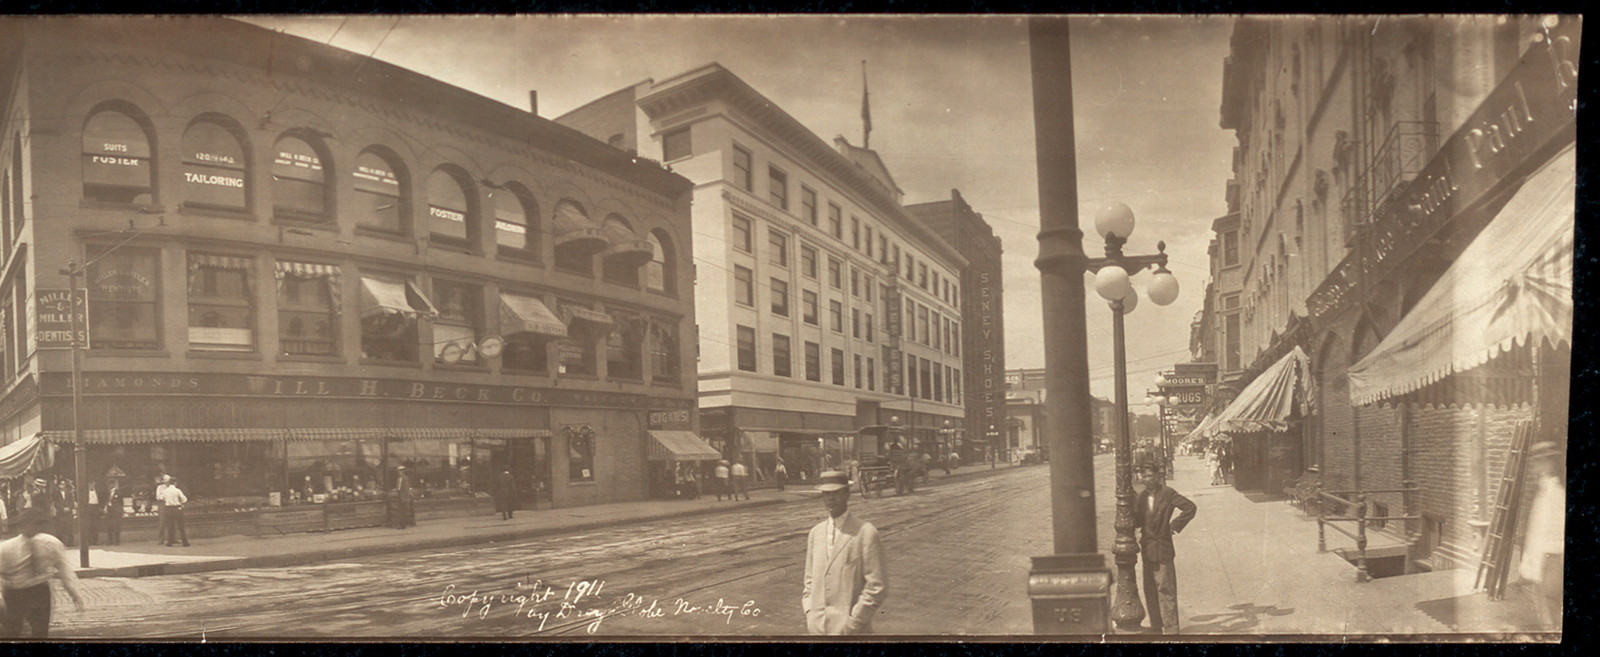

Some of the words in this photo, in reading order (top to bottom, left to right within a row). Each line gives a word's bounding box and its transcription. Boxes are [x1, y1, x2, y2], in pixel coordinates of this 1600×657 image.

[1463, 79, 1534, 169] Paul
[103, 143, 128, 152] SUITS
[184, 172, 244, 188] TAILORING
[429, 206, 465, 222] FOSTER
[57, 302, 65, 311] &
[980, 272, 992, 340] SENEY
[38, 330, 85, 341] DENTISS
[247, 376, 331, 396] WILL
[409, 382, 490, 401] BECK
[983, 350, 994, 417] SHOES
[651, 410, 690, 424] CIGARS
